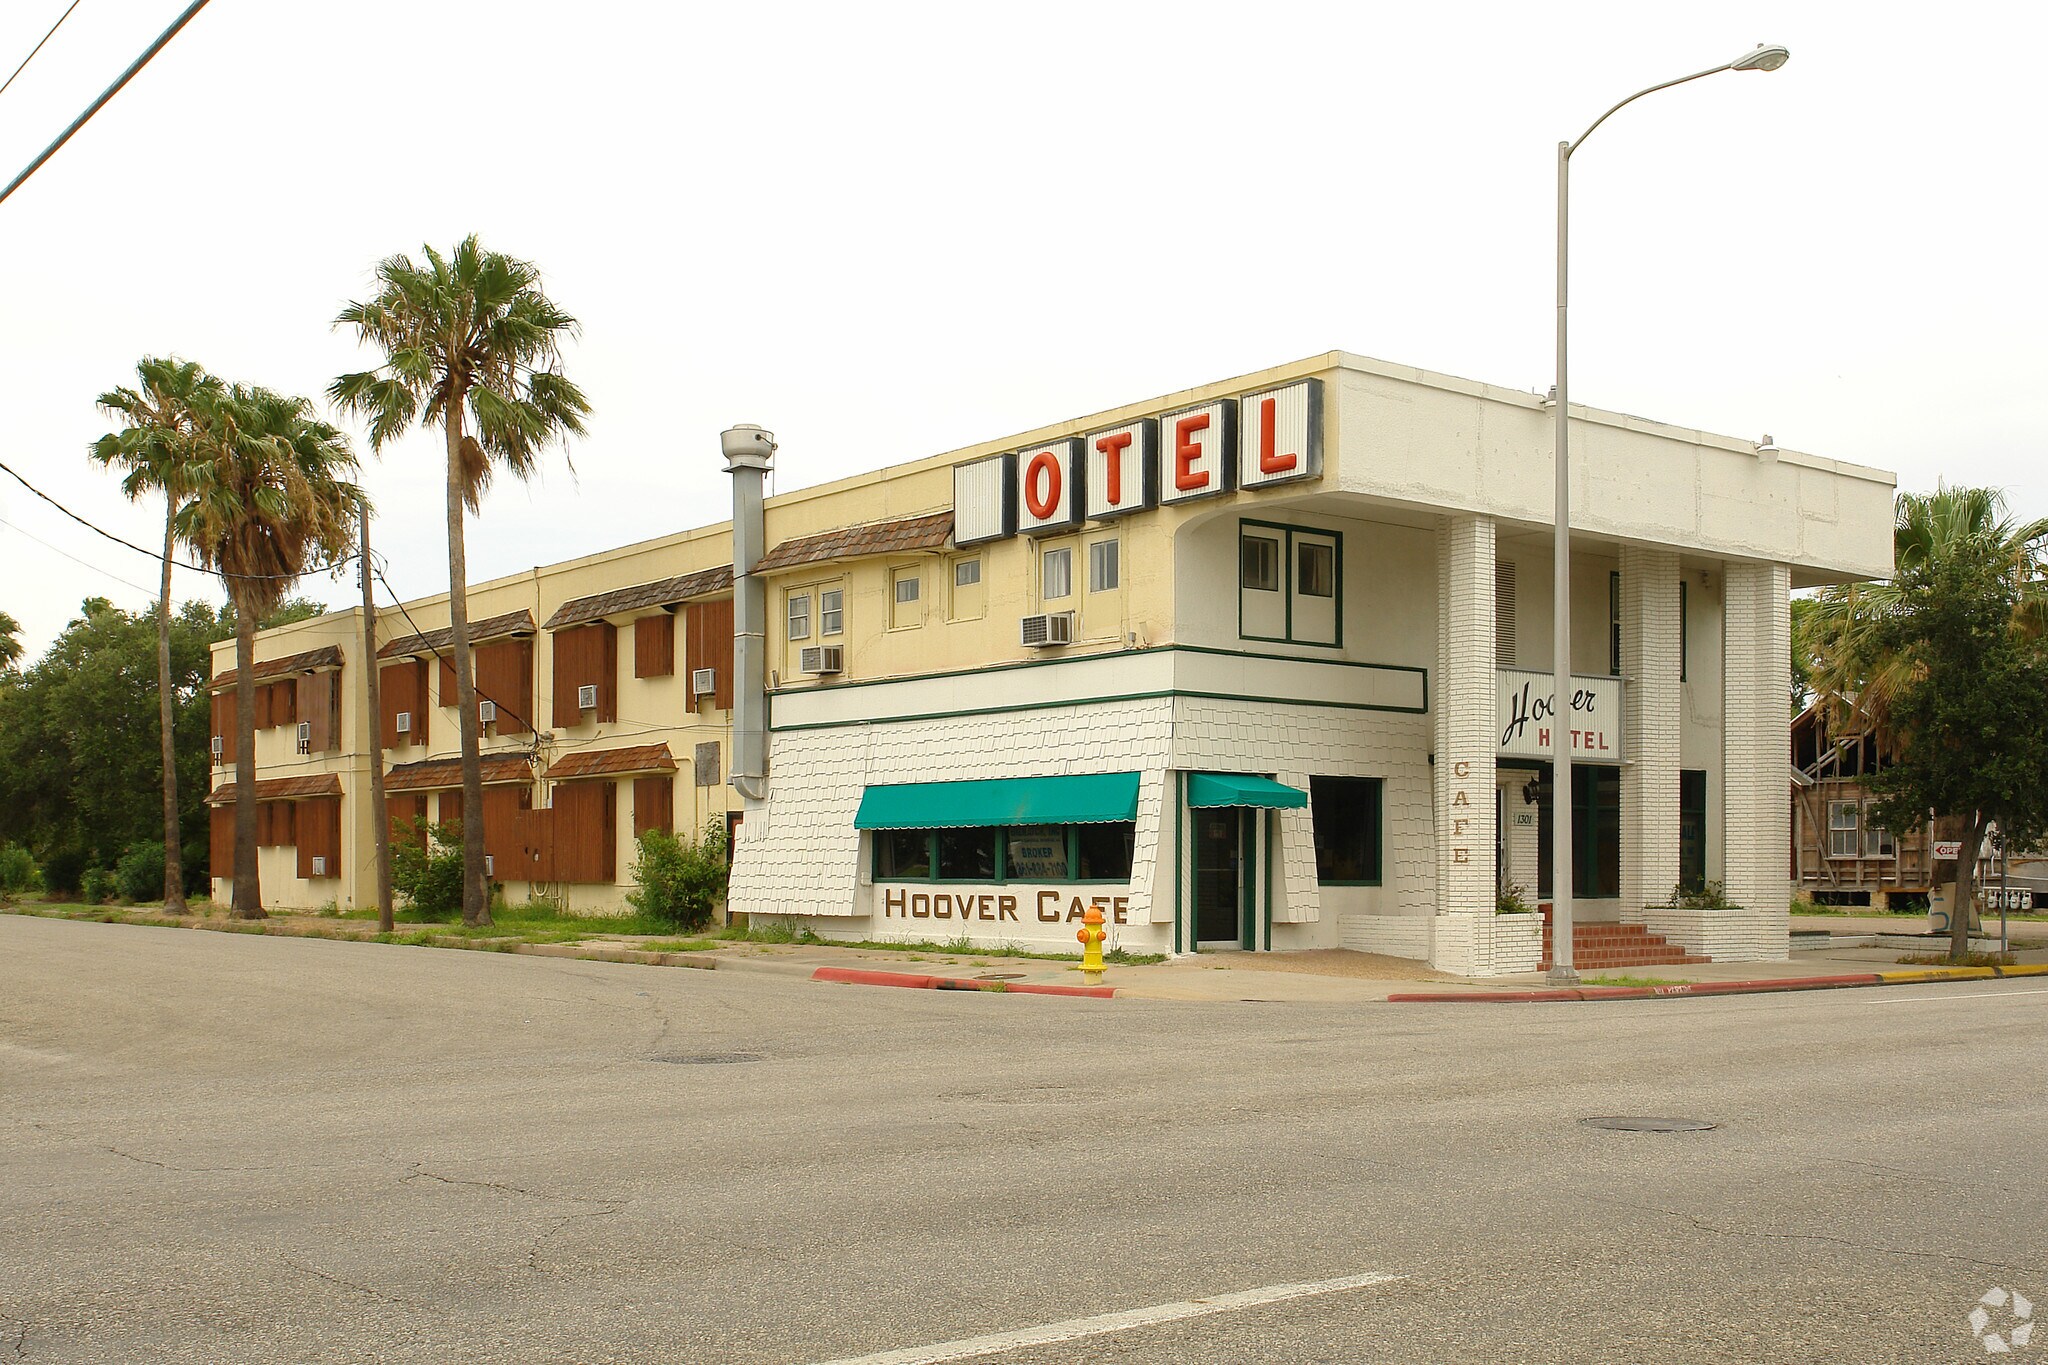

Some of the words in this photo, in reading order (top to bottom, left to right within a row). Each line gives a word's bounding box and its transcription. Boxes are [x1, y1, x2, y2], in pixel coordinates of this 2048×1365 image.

[1025, 398, 1297, 520] OTEL
[1501, 681, 1596, 746] Hooer
[1539, 728, 1609, 750] HTEL
[1452, 761, 1470, 864] CAFE
[1517, 814, 1532, 824] 1301
[1021, 847, 1054, 858] BROKER
[1940, 846, 1960, 854] OPE
[885, 888, 1019, 922] HOOVER
